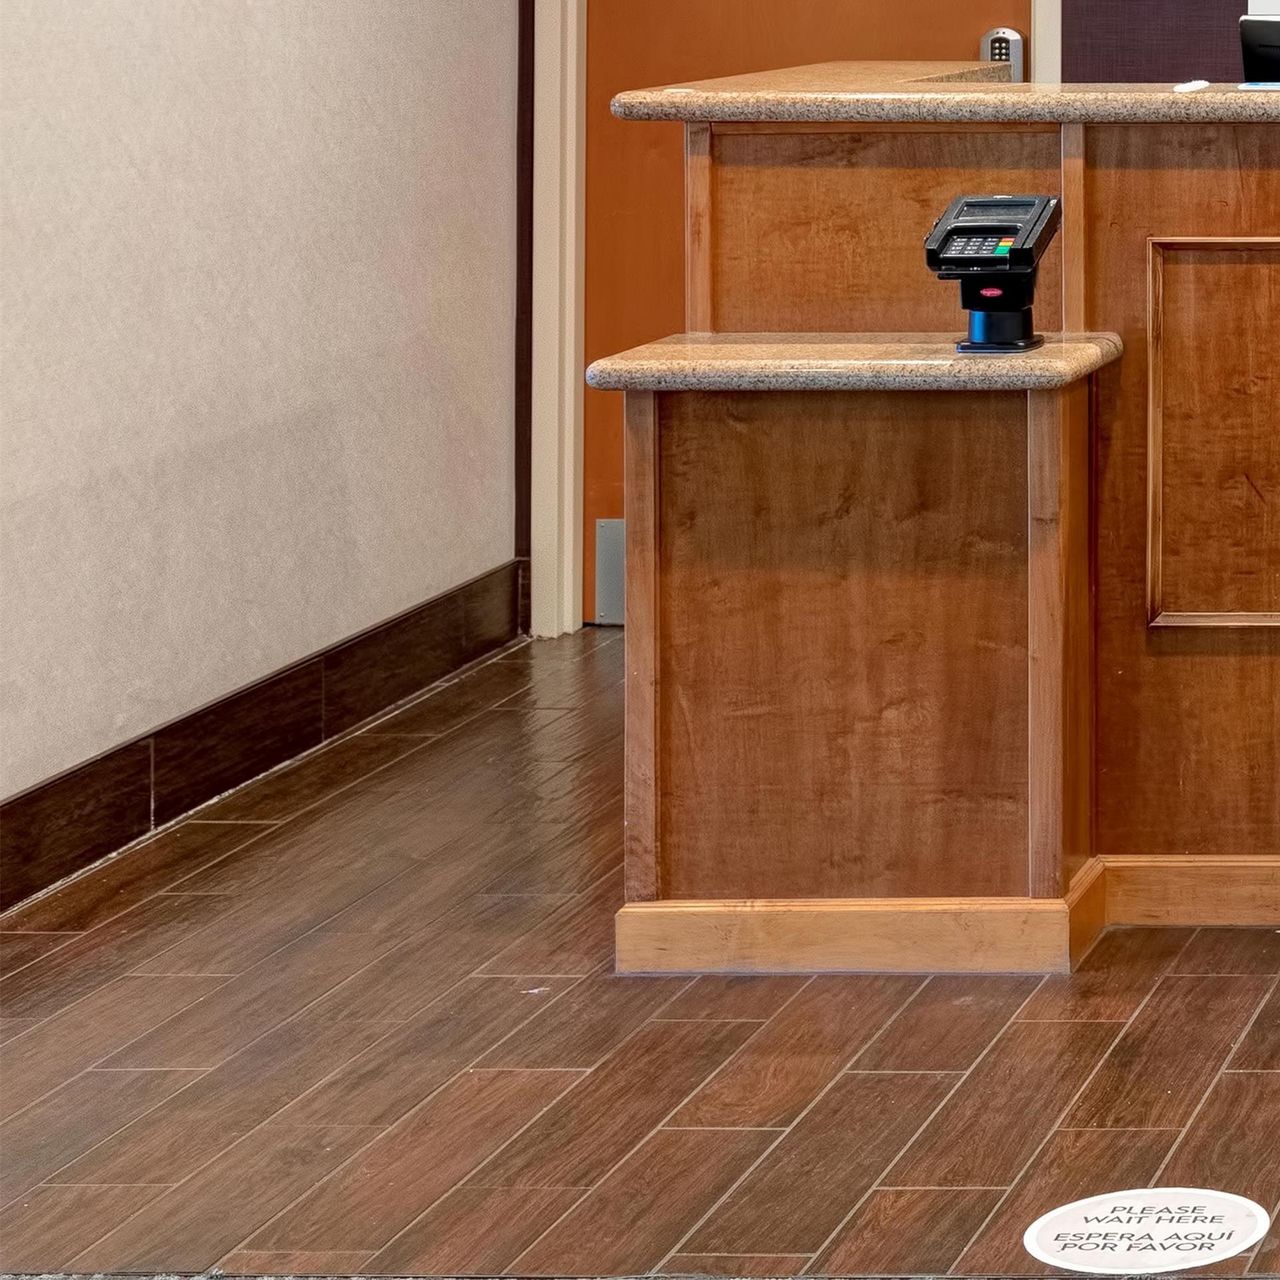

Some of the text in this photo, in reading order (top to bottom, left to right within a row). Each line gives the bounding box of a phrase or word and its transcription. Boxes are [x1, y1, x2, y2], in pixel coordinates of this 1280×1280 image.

[1110, 1205, 1207, 1214] PLEASE
[1083, 1215, 1225, 1224] WAIT HERE
[1053, 1230, 1235, 1241] ESPERA AQUÍ
[1060, 1242, 1216, 1252] POR FAVOR
